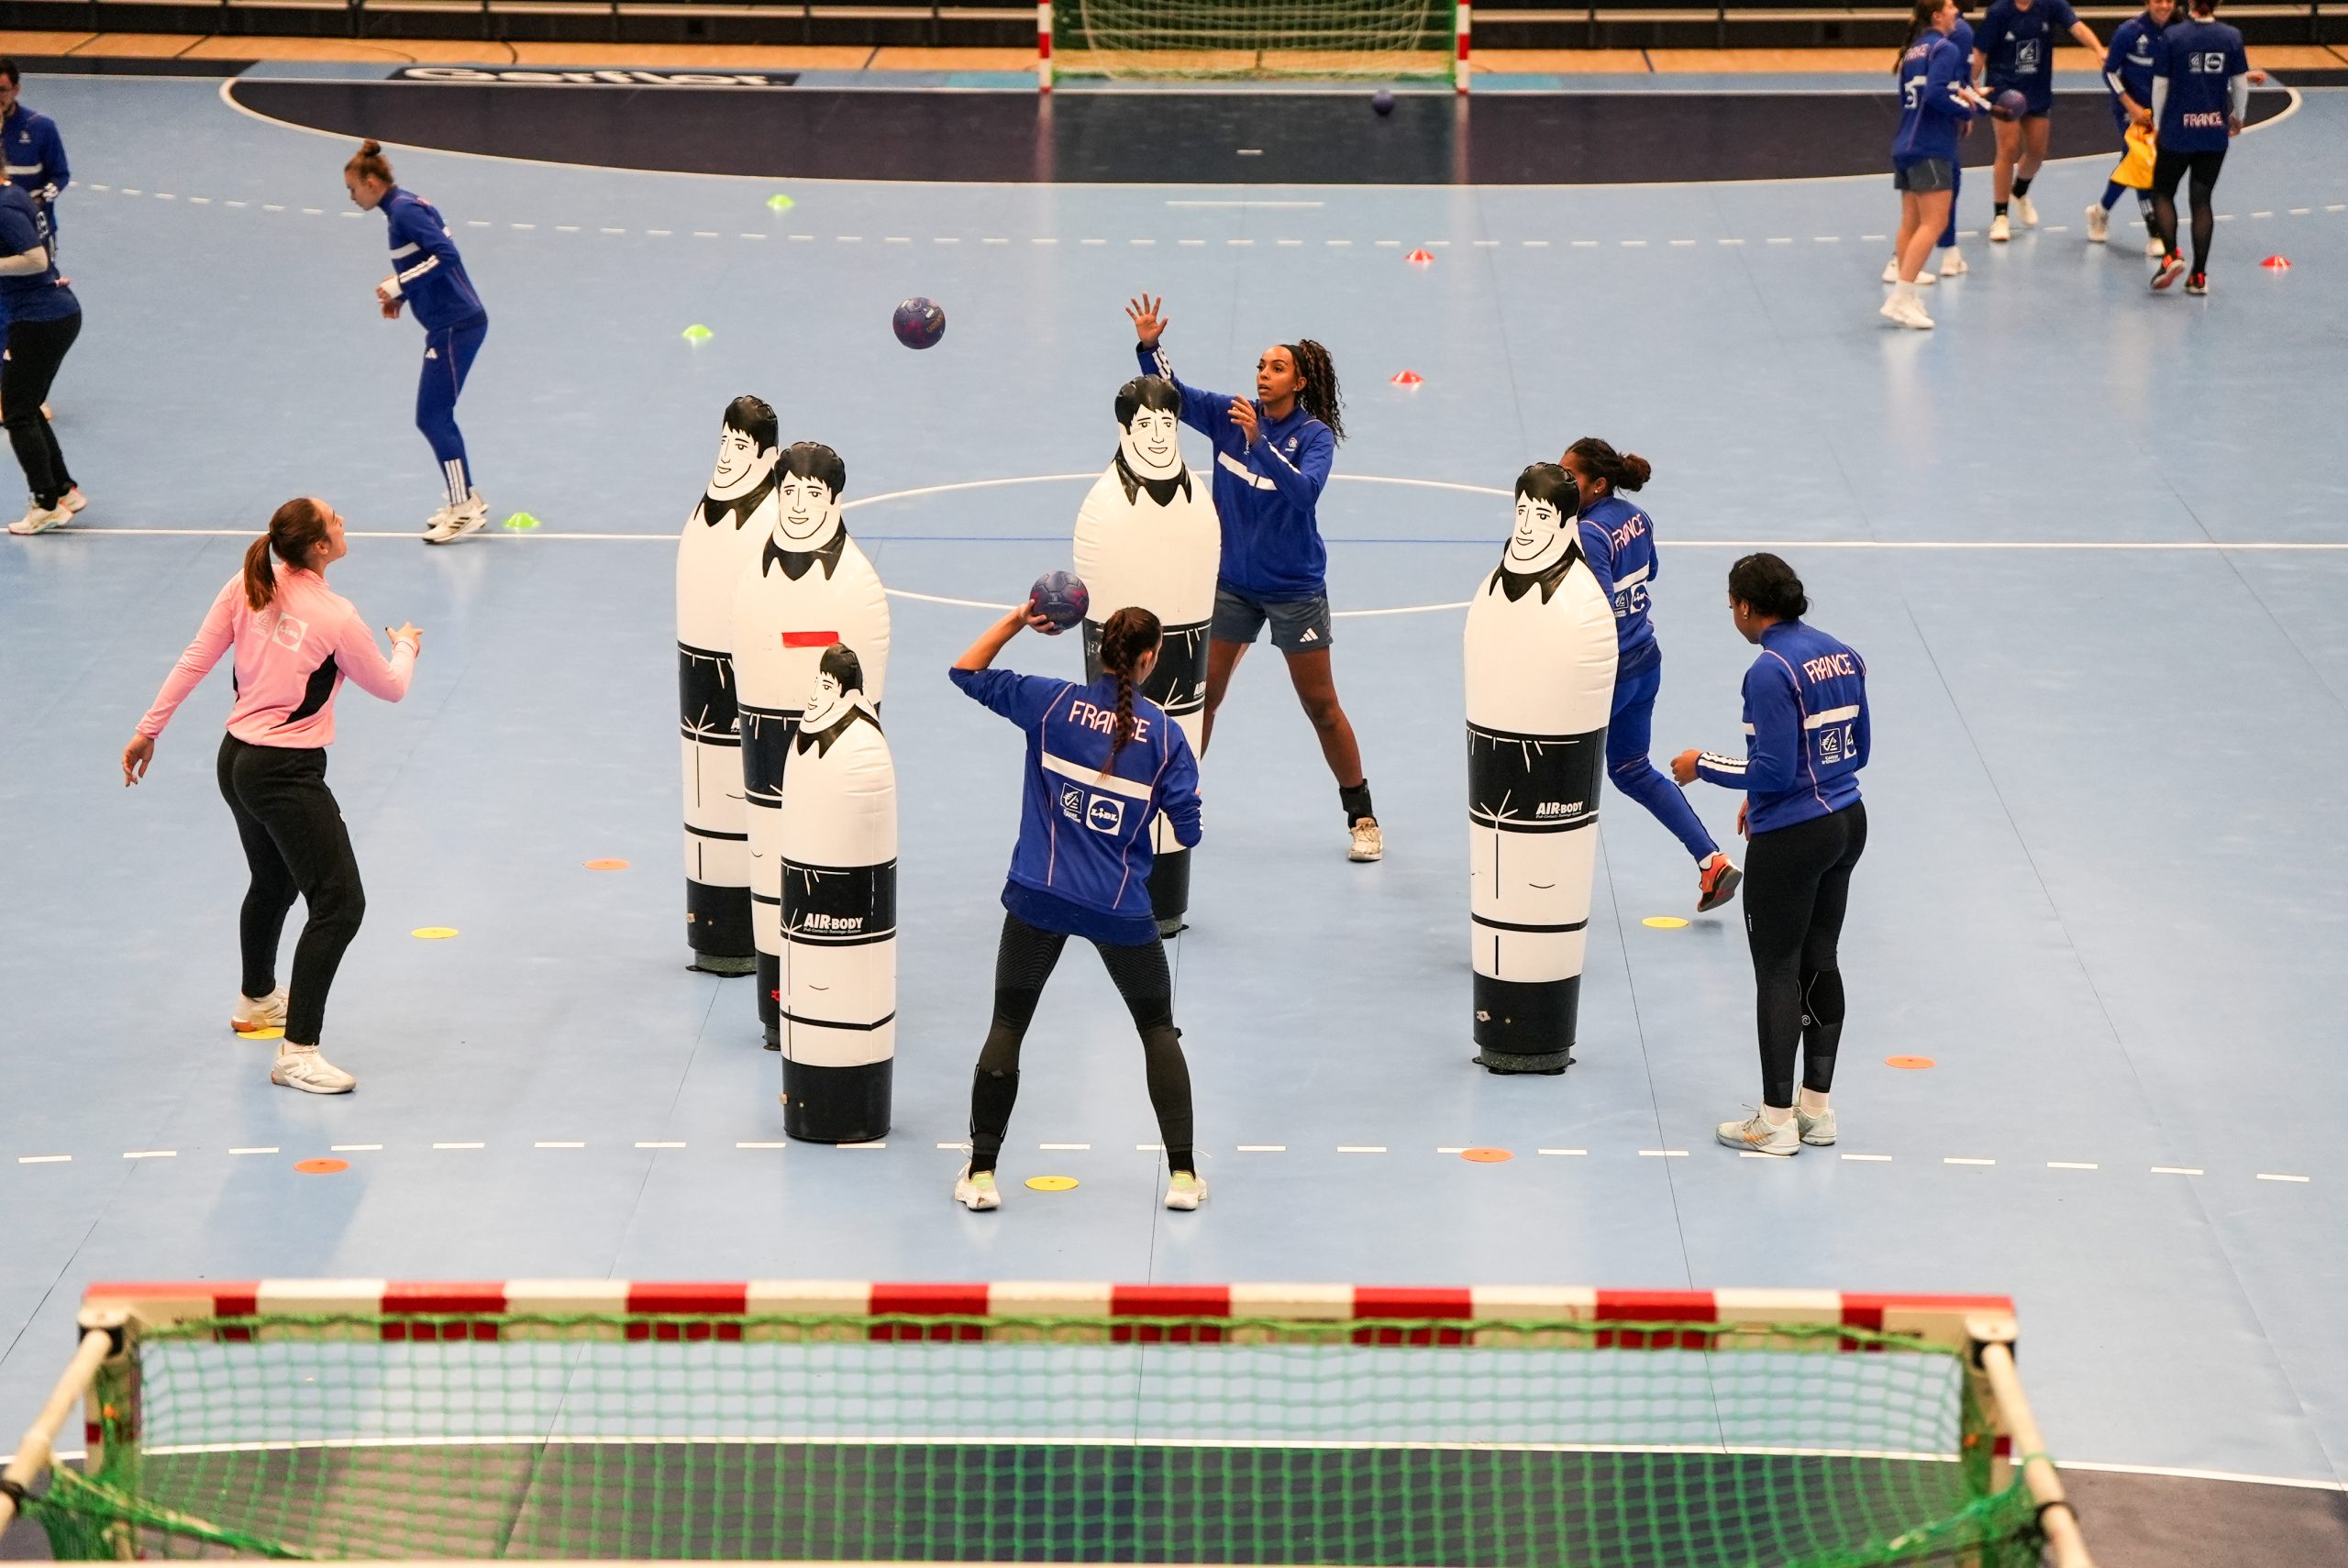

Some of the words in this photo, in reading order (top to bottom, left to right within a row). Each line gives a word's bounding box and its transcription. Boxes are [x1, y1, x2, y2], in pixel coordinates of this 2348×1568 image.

[2184, 112, 2223, 127] FRANCE
[1803, 654, 1855, 683] FRANCE
[803, 913, 863, 929] AIR-BODY
